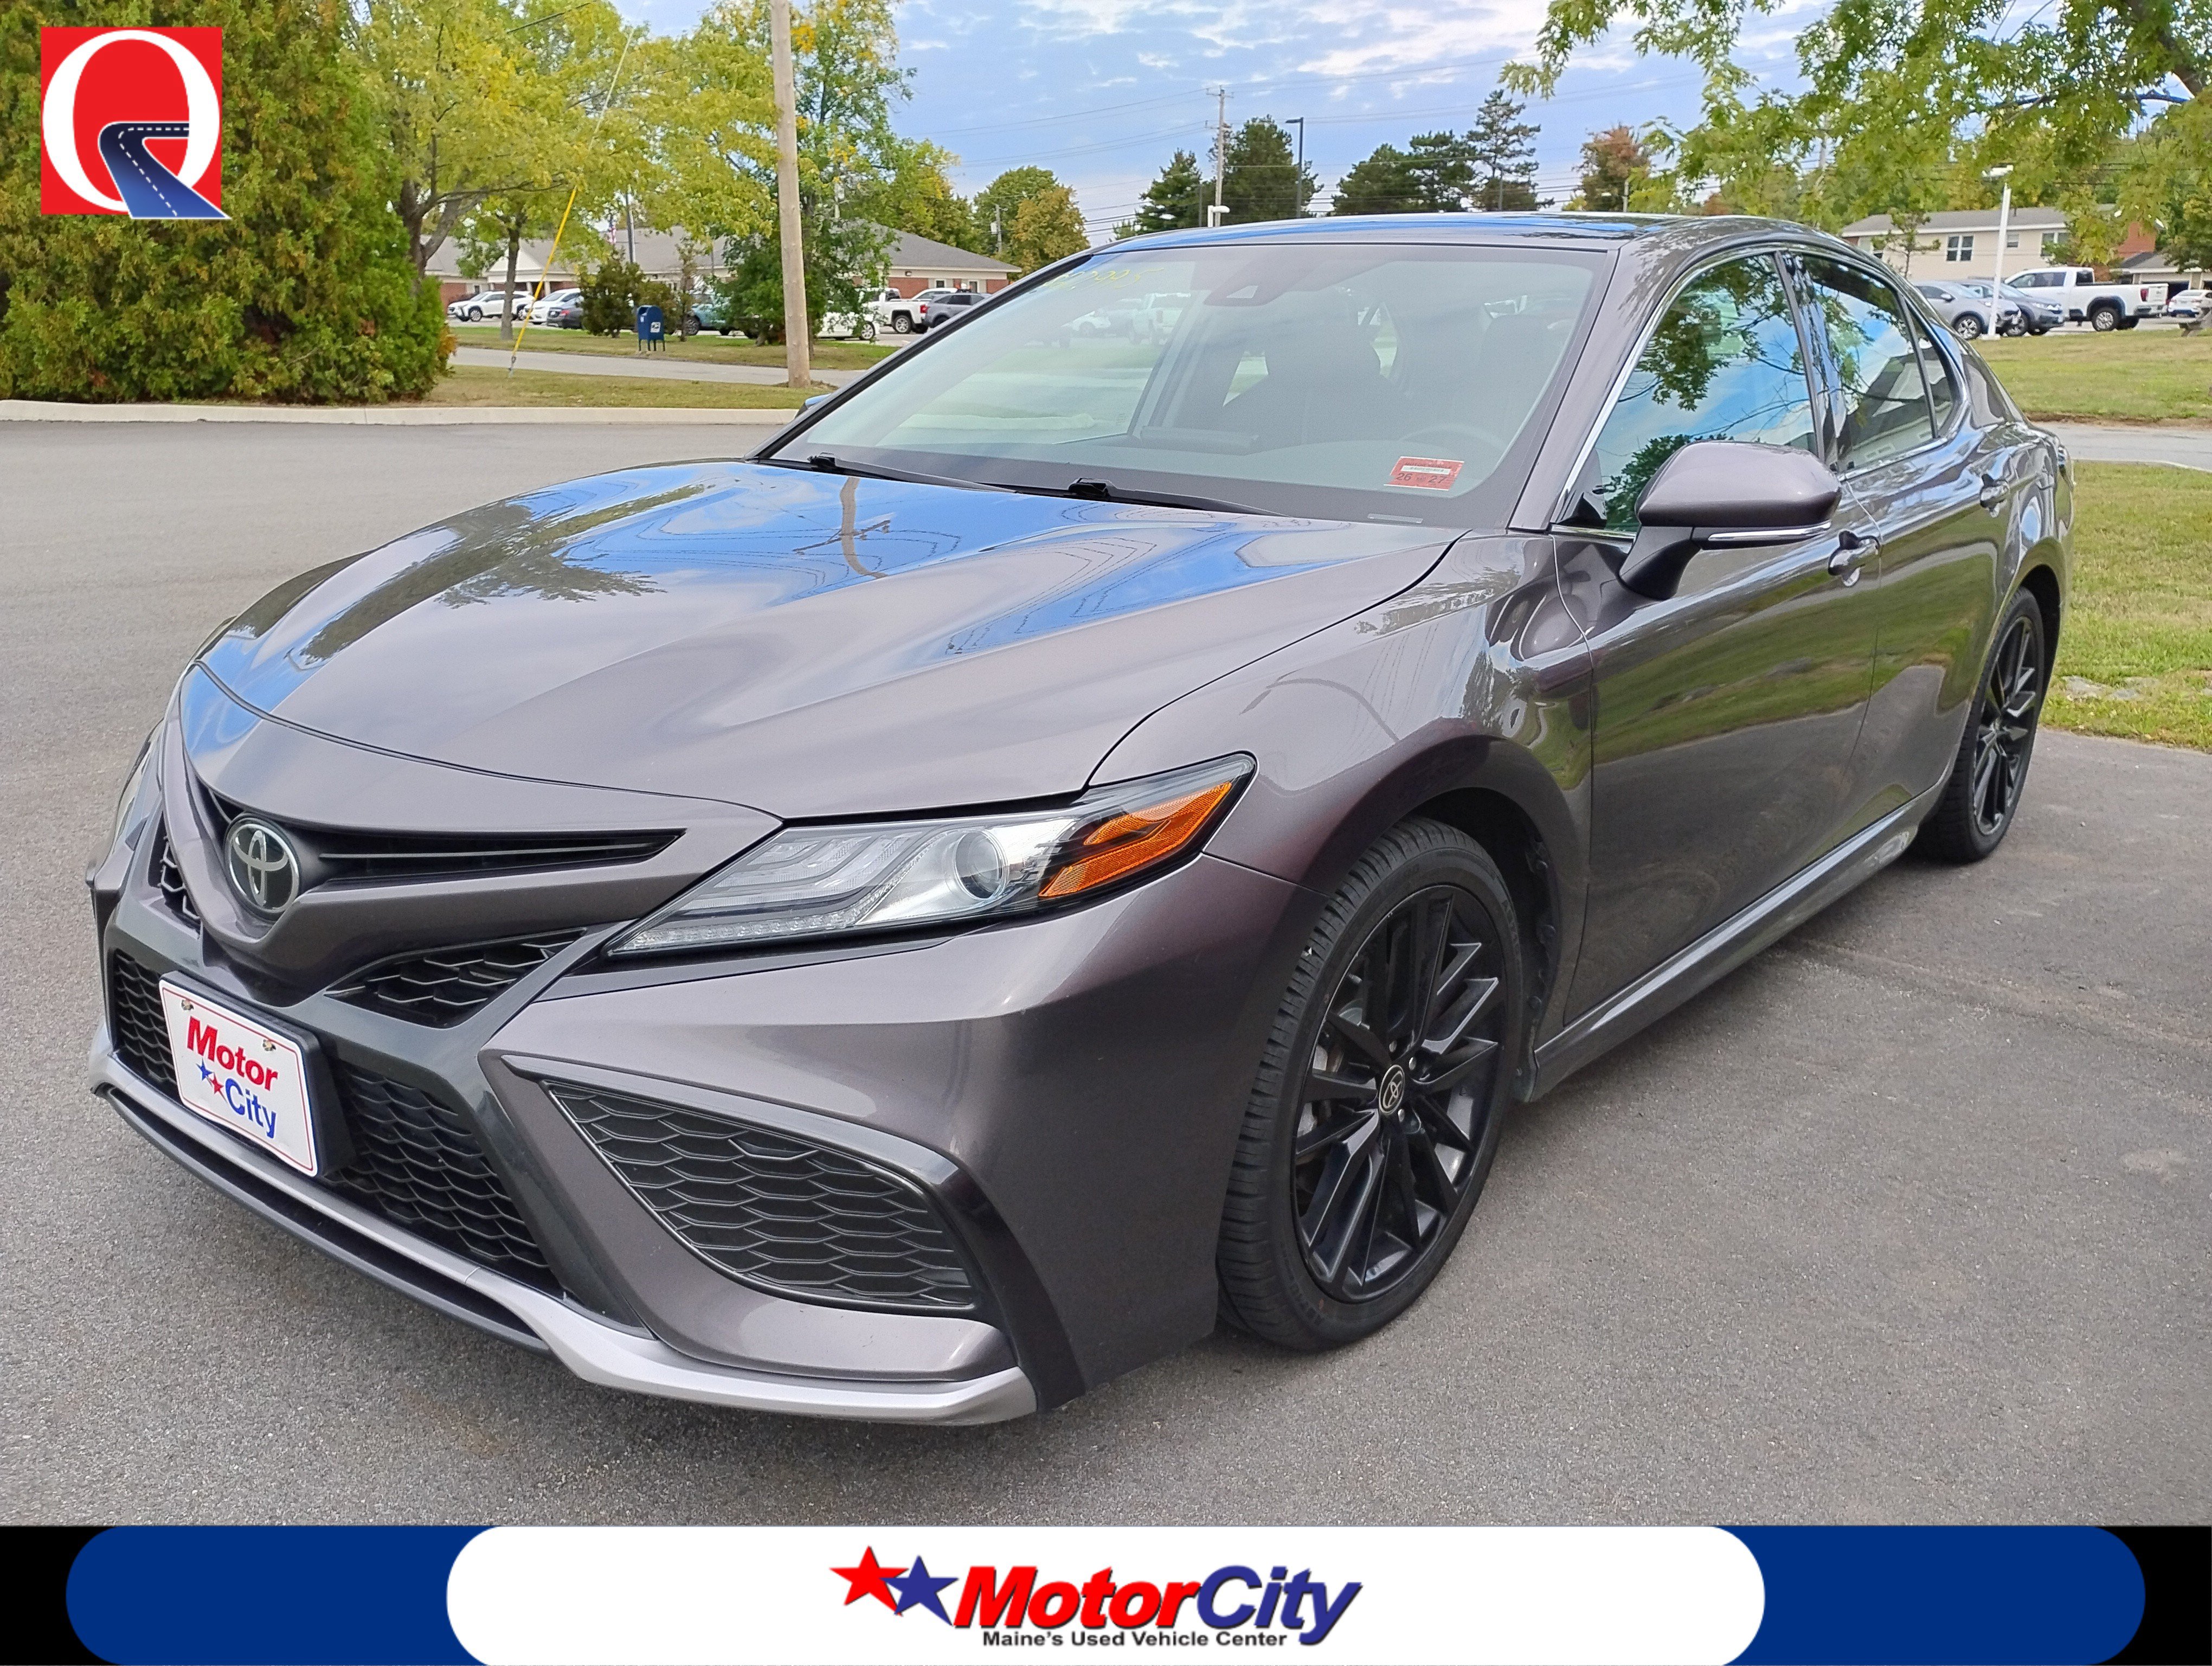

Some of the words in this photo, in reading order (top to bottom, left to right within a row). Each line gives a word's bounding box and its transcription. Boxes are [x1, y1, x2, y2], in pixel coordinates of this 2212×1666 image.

[1396, 472, 1412, 481] 26
[1428, 475, 1447, 484] 27
[187, 1016, 278, 1091] Motor
[225, 1078, 277, 1139] City
